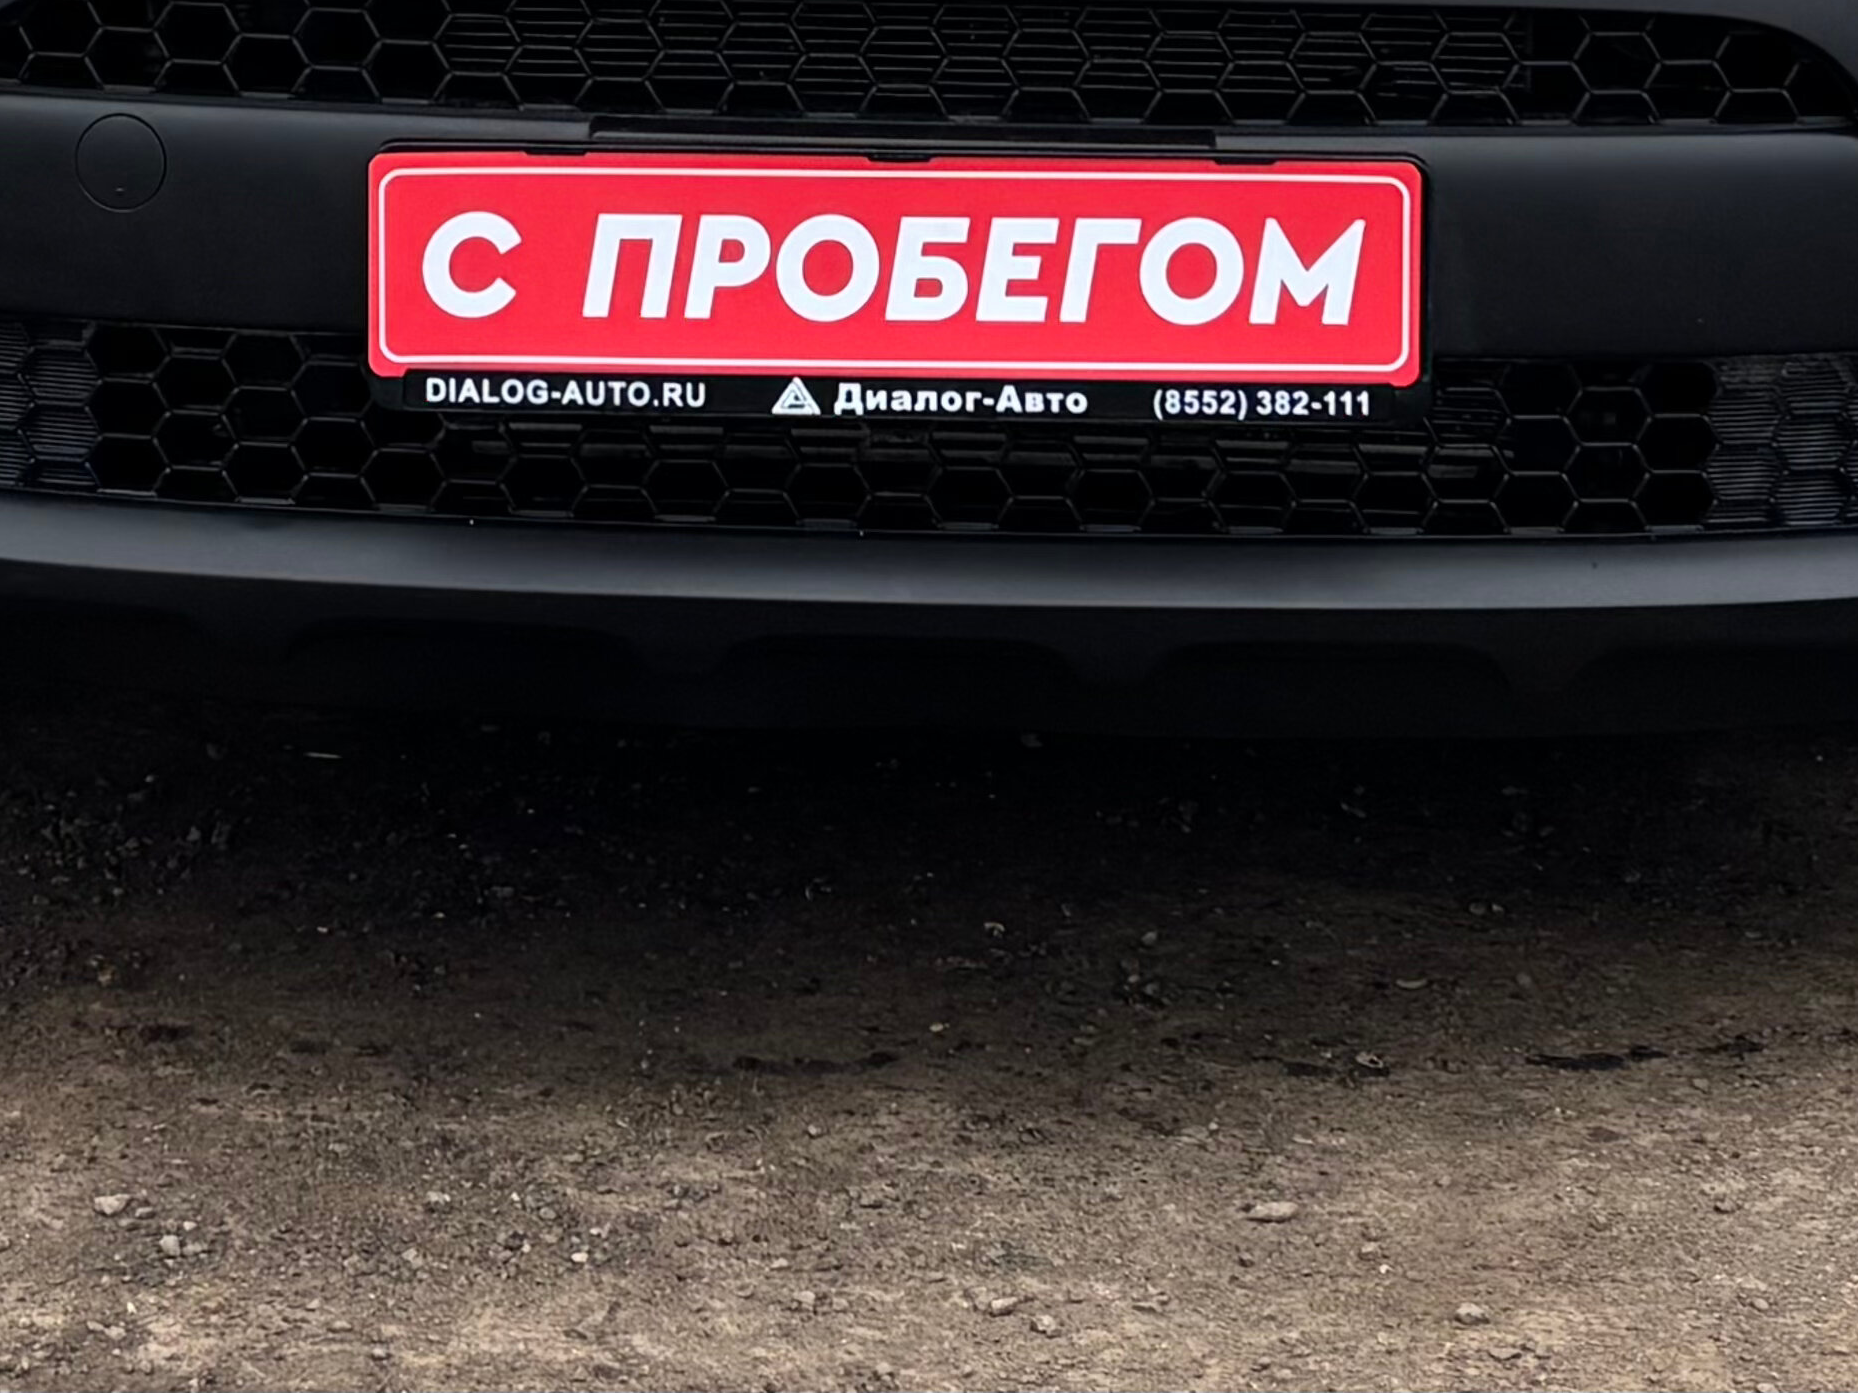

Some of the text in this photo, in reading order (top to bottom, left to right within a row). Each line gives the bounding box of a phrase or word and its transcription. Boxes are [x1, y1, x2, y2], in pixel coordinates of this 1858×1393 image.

[422, 209, 1365, 326] С ПРОБЕГОМ
[425, 377, 706, 408] DIALOG-AUTO.RU
[833, 382, 1088, 415] Диалог-Авто
[1152, 389, 1370, 421] (8552) 382-111
